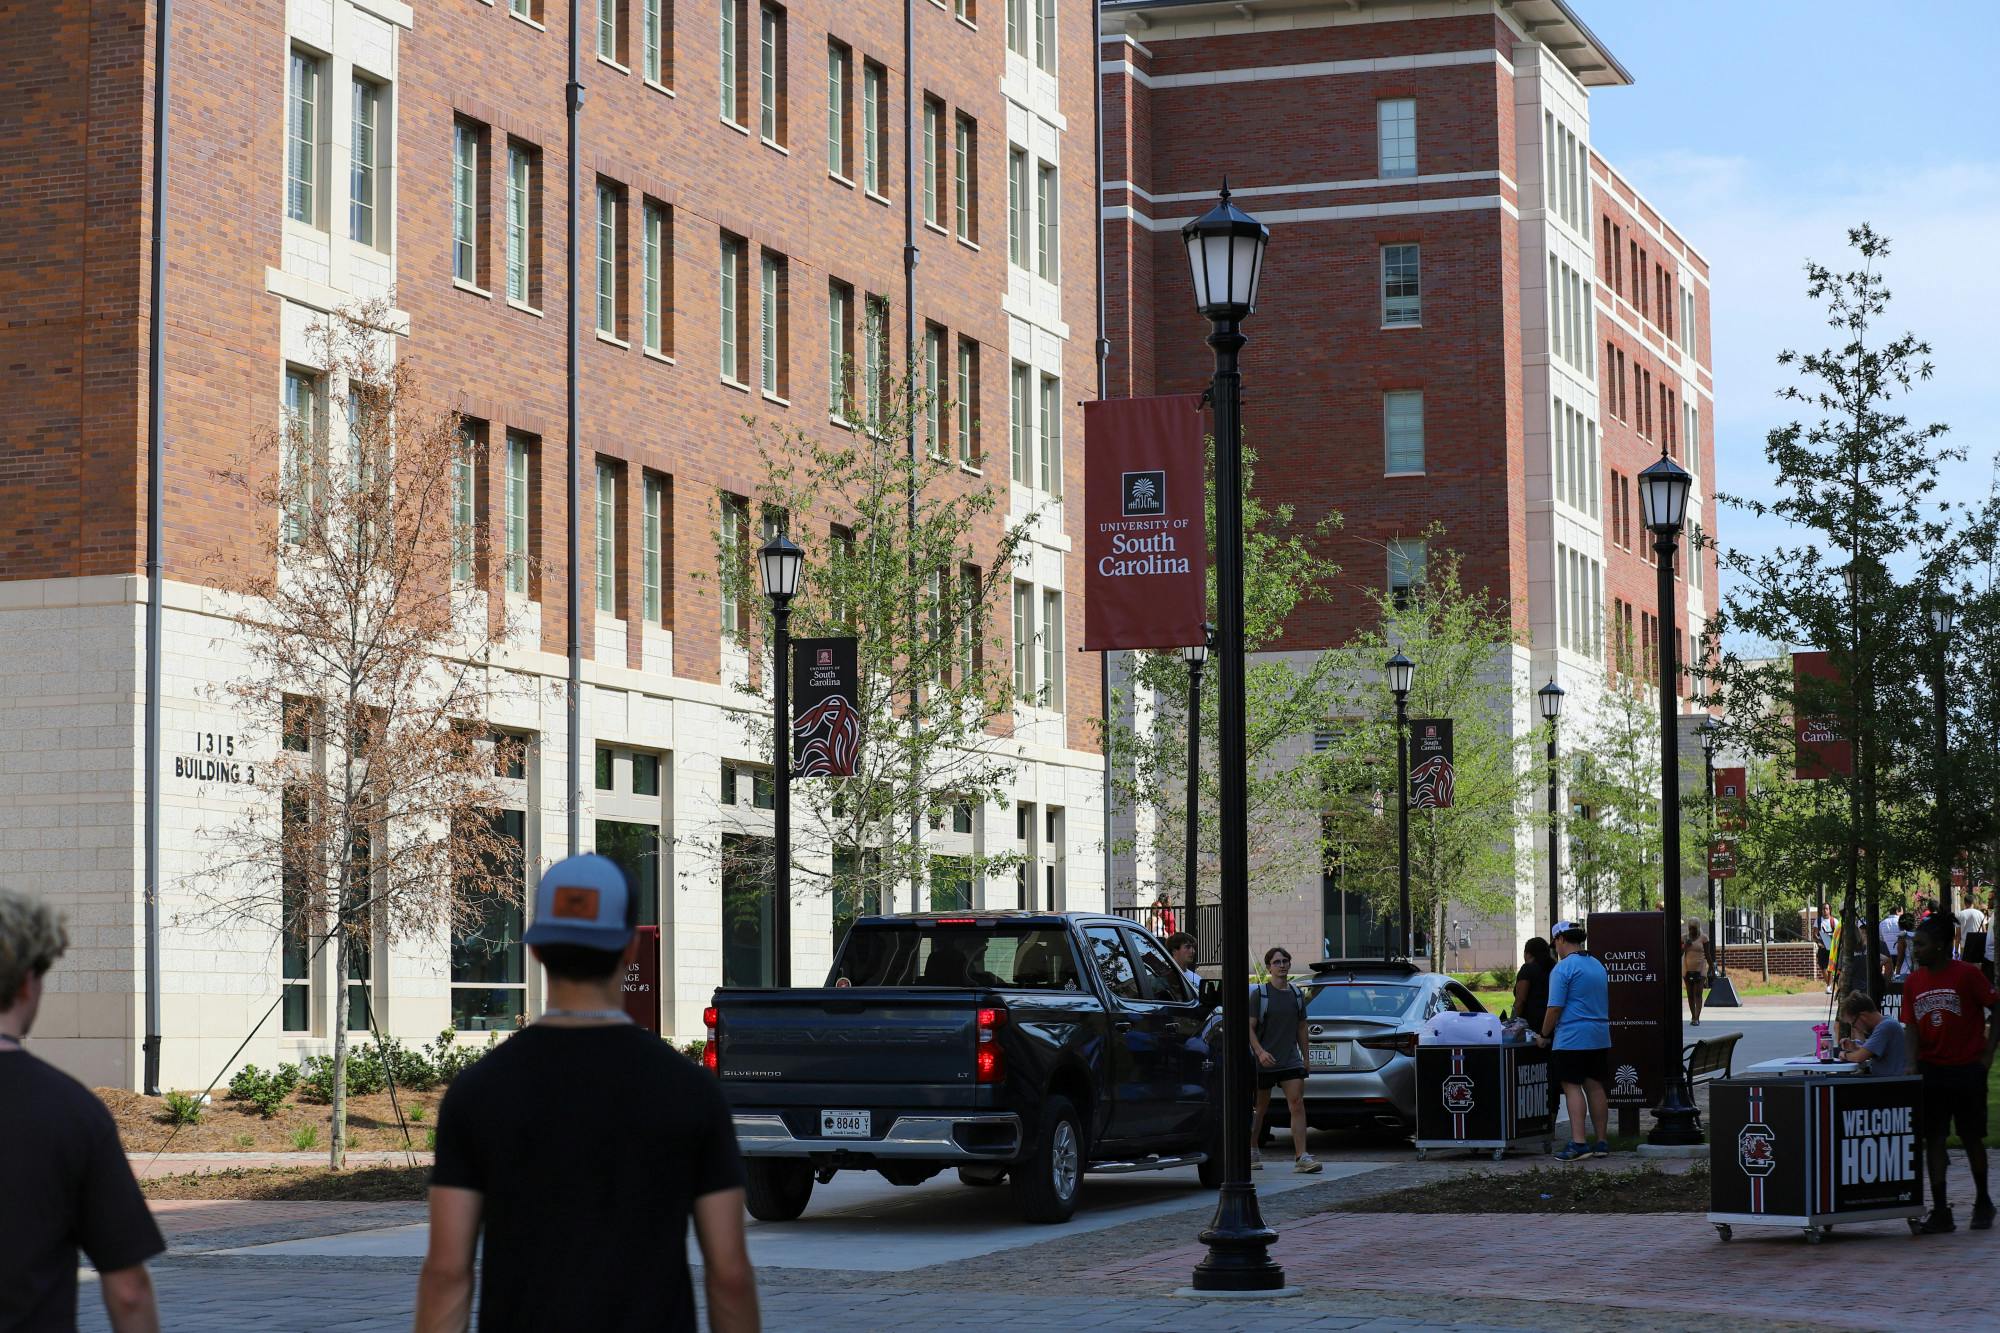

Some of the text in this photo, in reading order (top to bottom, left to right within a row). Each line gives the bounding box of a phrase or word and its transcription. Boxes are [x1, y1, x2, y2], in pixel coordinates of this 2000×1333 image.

[1100, 519, 1189, 532] UNIVERSITY OF
[1112, 532, 1176, 554] South
[1099, 554, 1190, 577] Carolina
[809, 679, 841, 687] Carolina
[814, 671, 836, 679] South
[197, 732, 234, 756] 1315
[175, 756, 255, 785] BUILDING 3
[1604, 951, 1646, 960] CAMPUS
[1604, 962, 1647, 971] VILLAGE
[1607, 973, 1657, 982] ILDING #1
[1518, 1063, 1548, 1085] WELCOME
[1517, 1082, 1550, 1119] HOME
[836, 1117, 860, 1130] 8848
[1842, 1107, 1913, 1137] WELCOME
[1841, 1135, 1916, 1186] HOME
